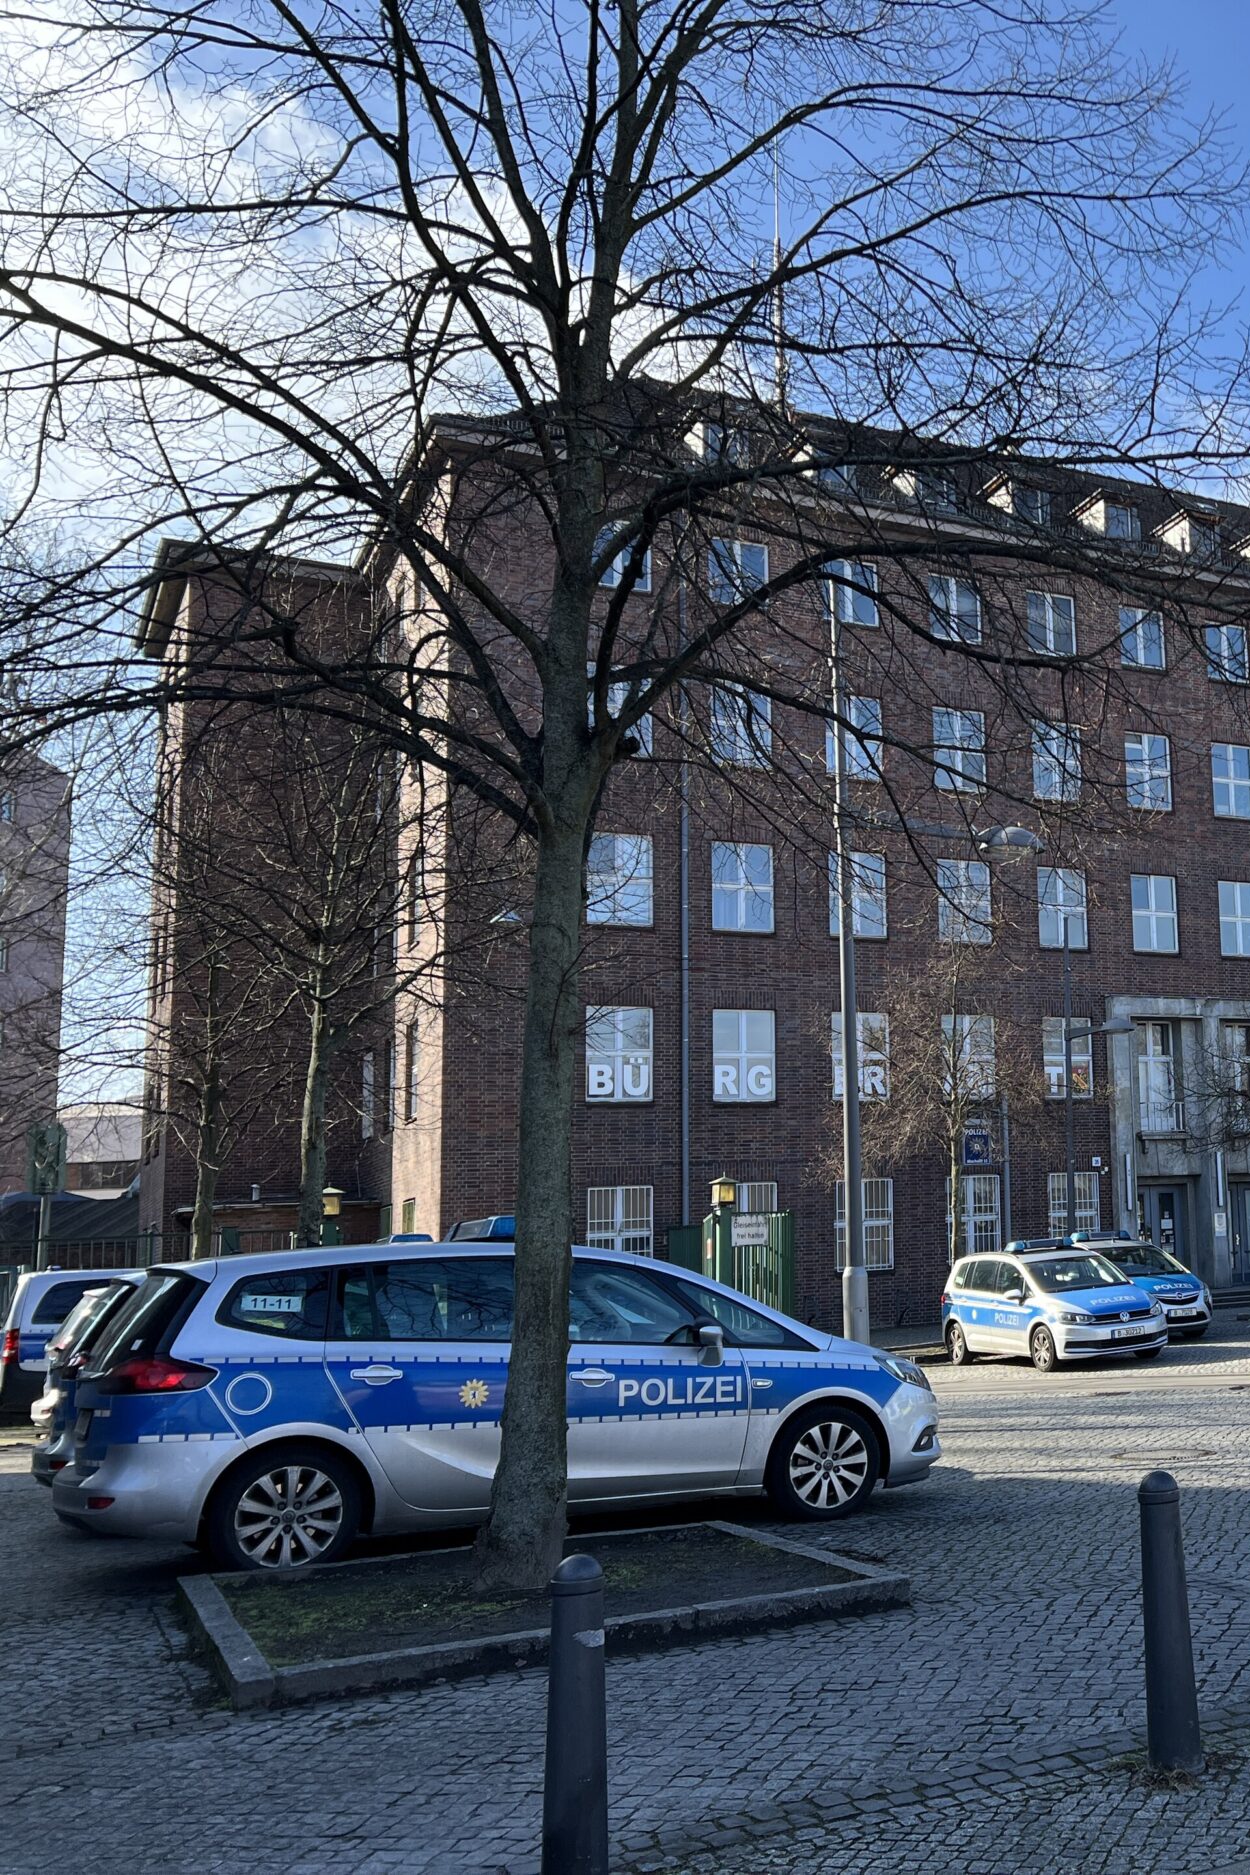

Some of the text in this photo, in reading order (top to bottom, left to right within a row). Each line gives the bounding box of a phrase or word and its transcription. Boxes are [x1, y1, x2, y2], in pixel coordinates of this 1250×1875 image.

[1153, 1283, 1194, 1292] POLIZEI
[250, 1297, 292, 1310] 11-11
[1089, 1295, 1137, 1306] POLIZEI
[994, 1312, 1020, 1326] POLIZEI
[618, 1375, 742, 1407] POLIZEI
